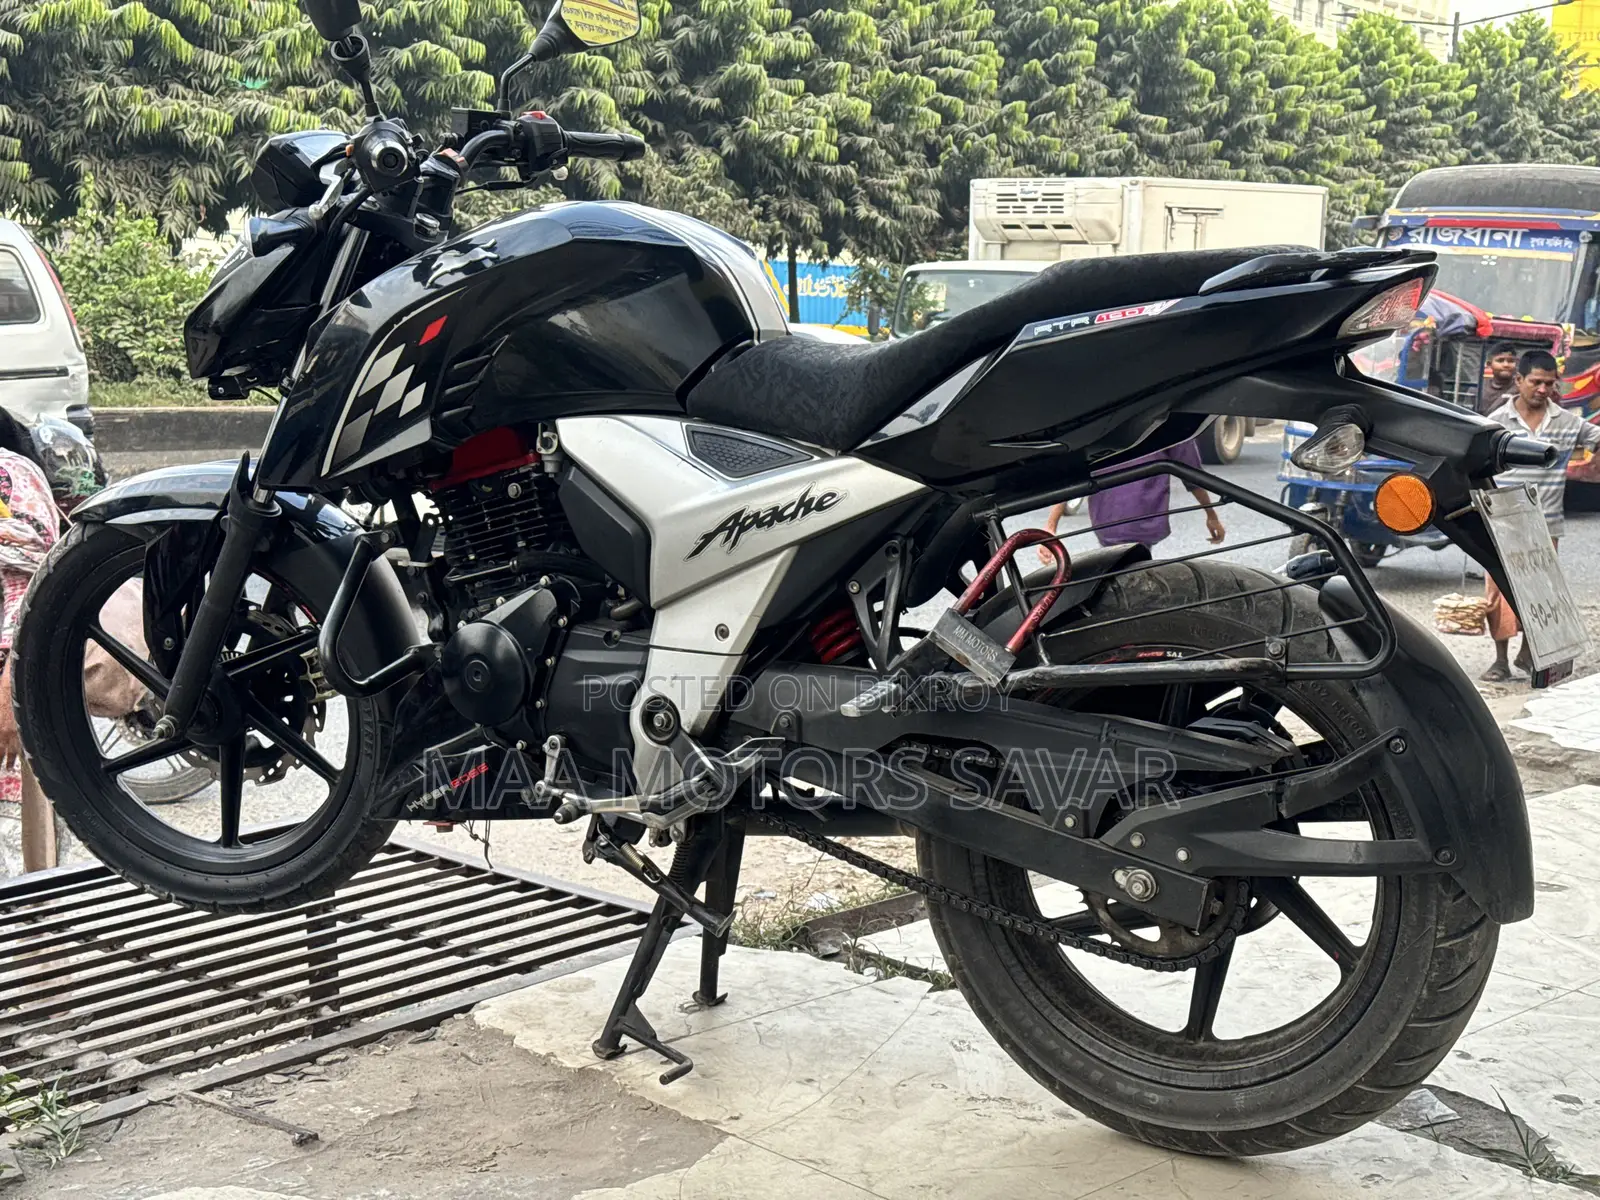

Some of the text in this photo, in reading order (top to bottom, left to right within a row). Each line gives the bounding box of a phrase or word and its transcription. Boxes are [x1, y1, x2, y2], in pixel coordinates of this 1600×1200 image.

[1034, 316, 1090, 336] RTR
[685, 483, 848, 560] Apache
[953, 625, 999, 661] MM MOTORS
[406, 784, 452, 812] HYPER
